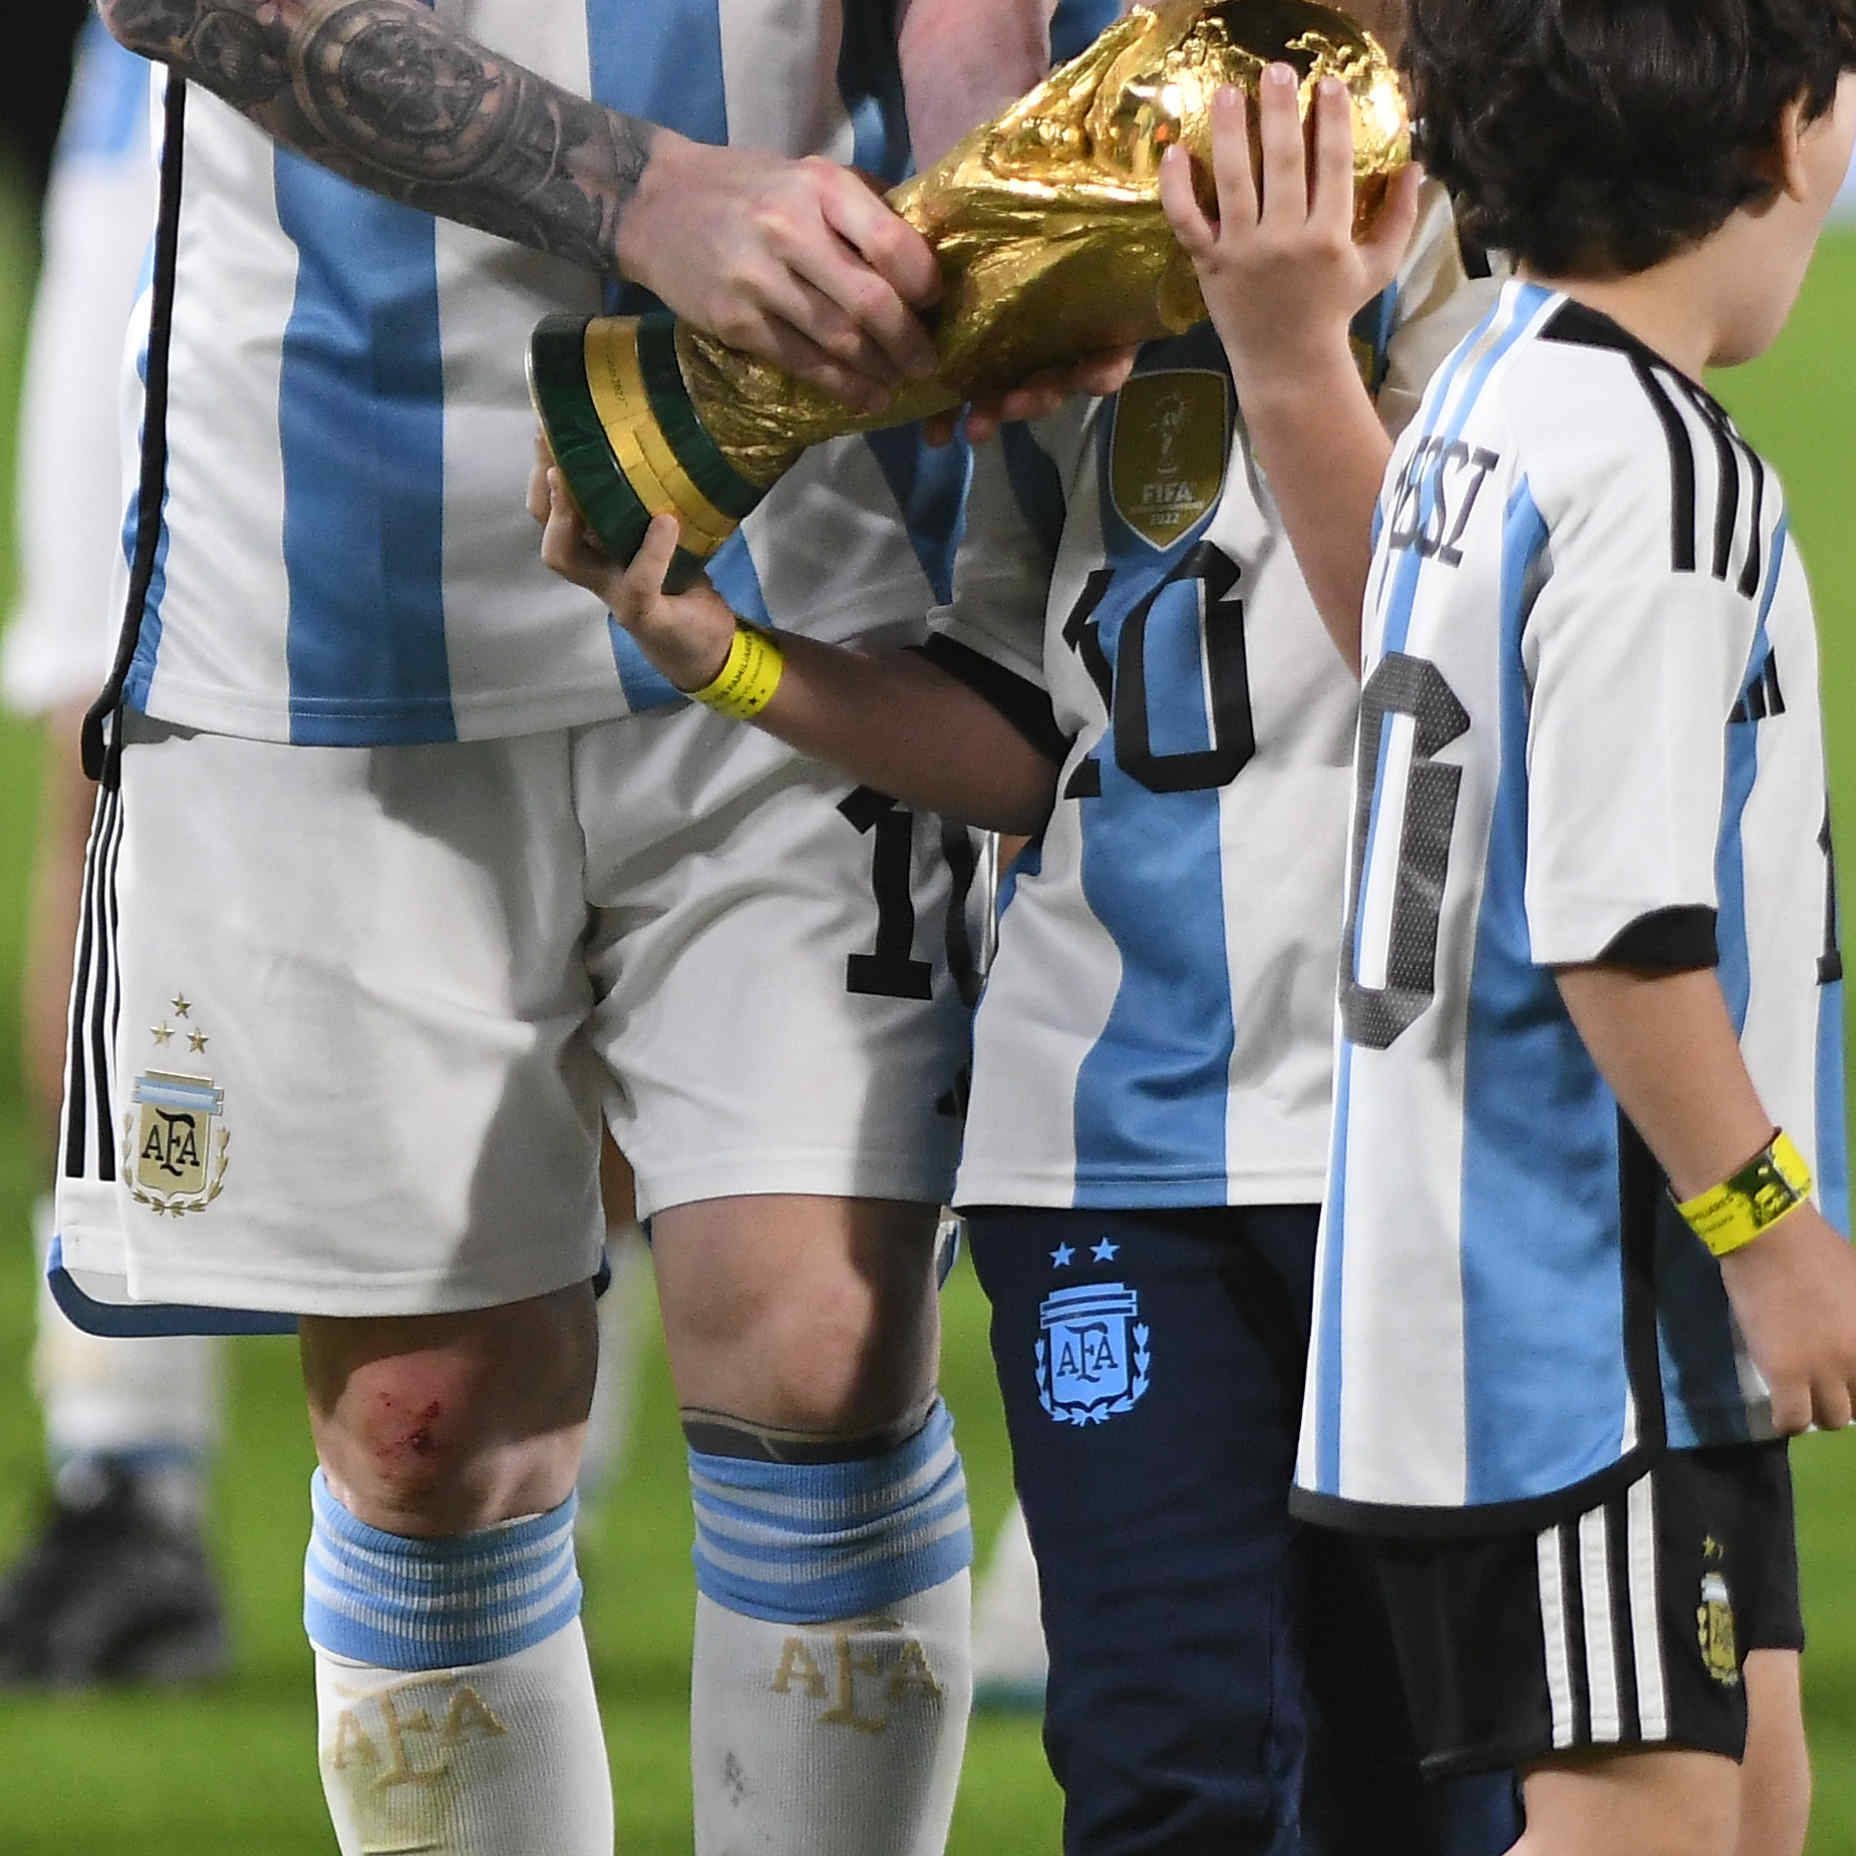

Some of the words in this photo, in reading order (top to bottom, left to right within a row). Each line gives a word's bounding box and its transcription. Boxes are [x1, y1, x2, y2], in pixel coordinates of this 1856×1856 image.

[1143, 481, 1193, 504] FIFA
[1061, 539, 1257, 800] 10
[141, 1108, 201, 1177] AFA
[1055, 1321, 1119, 1383] AFA
[770, 1617, 943, 1735] AFA
[333, 1670, 511, 1793] AFA
